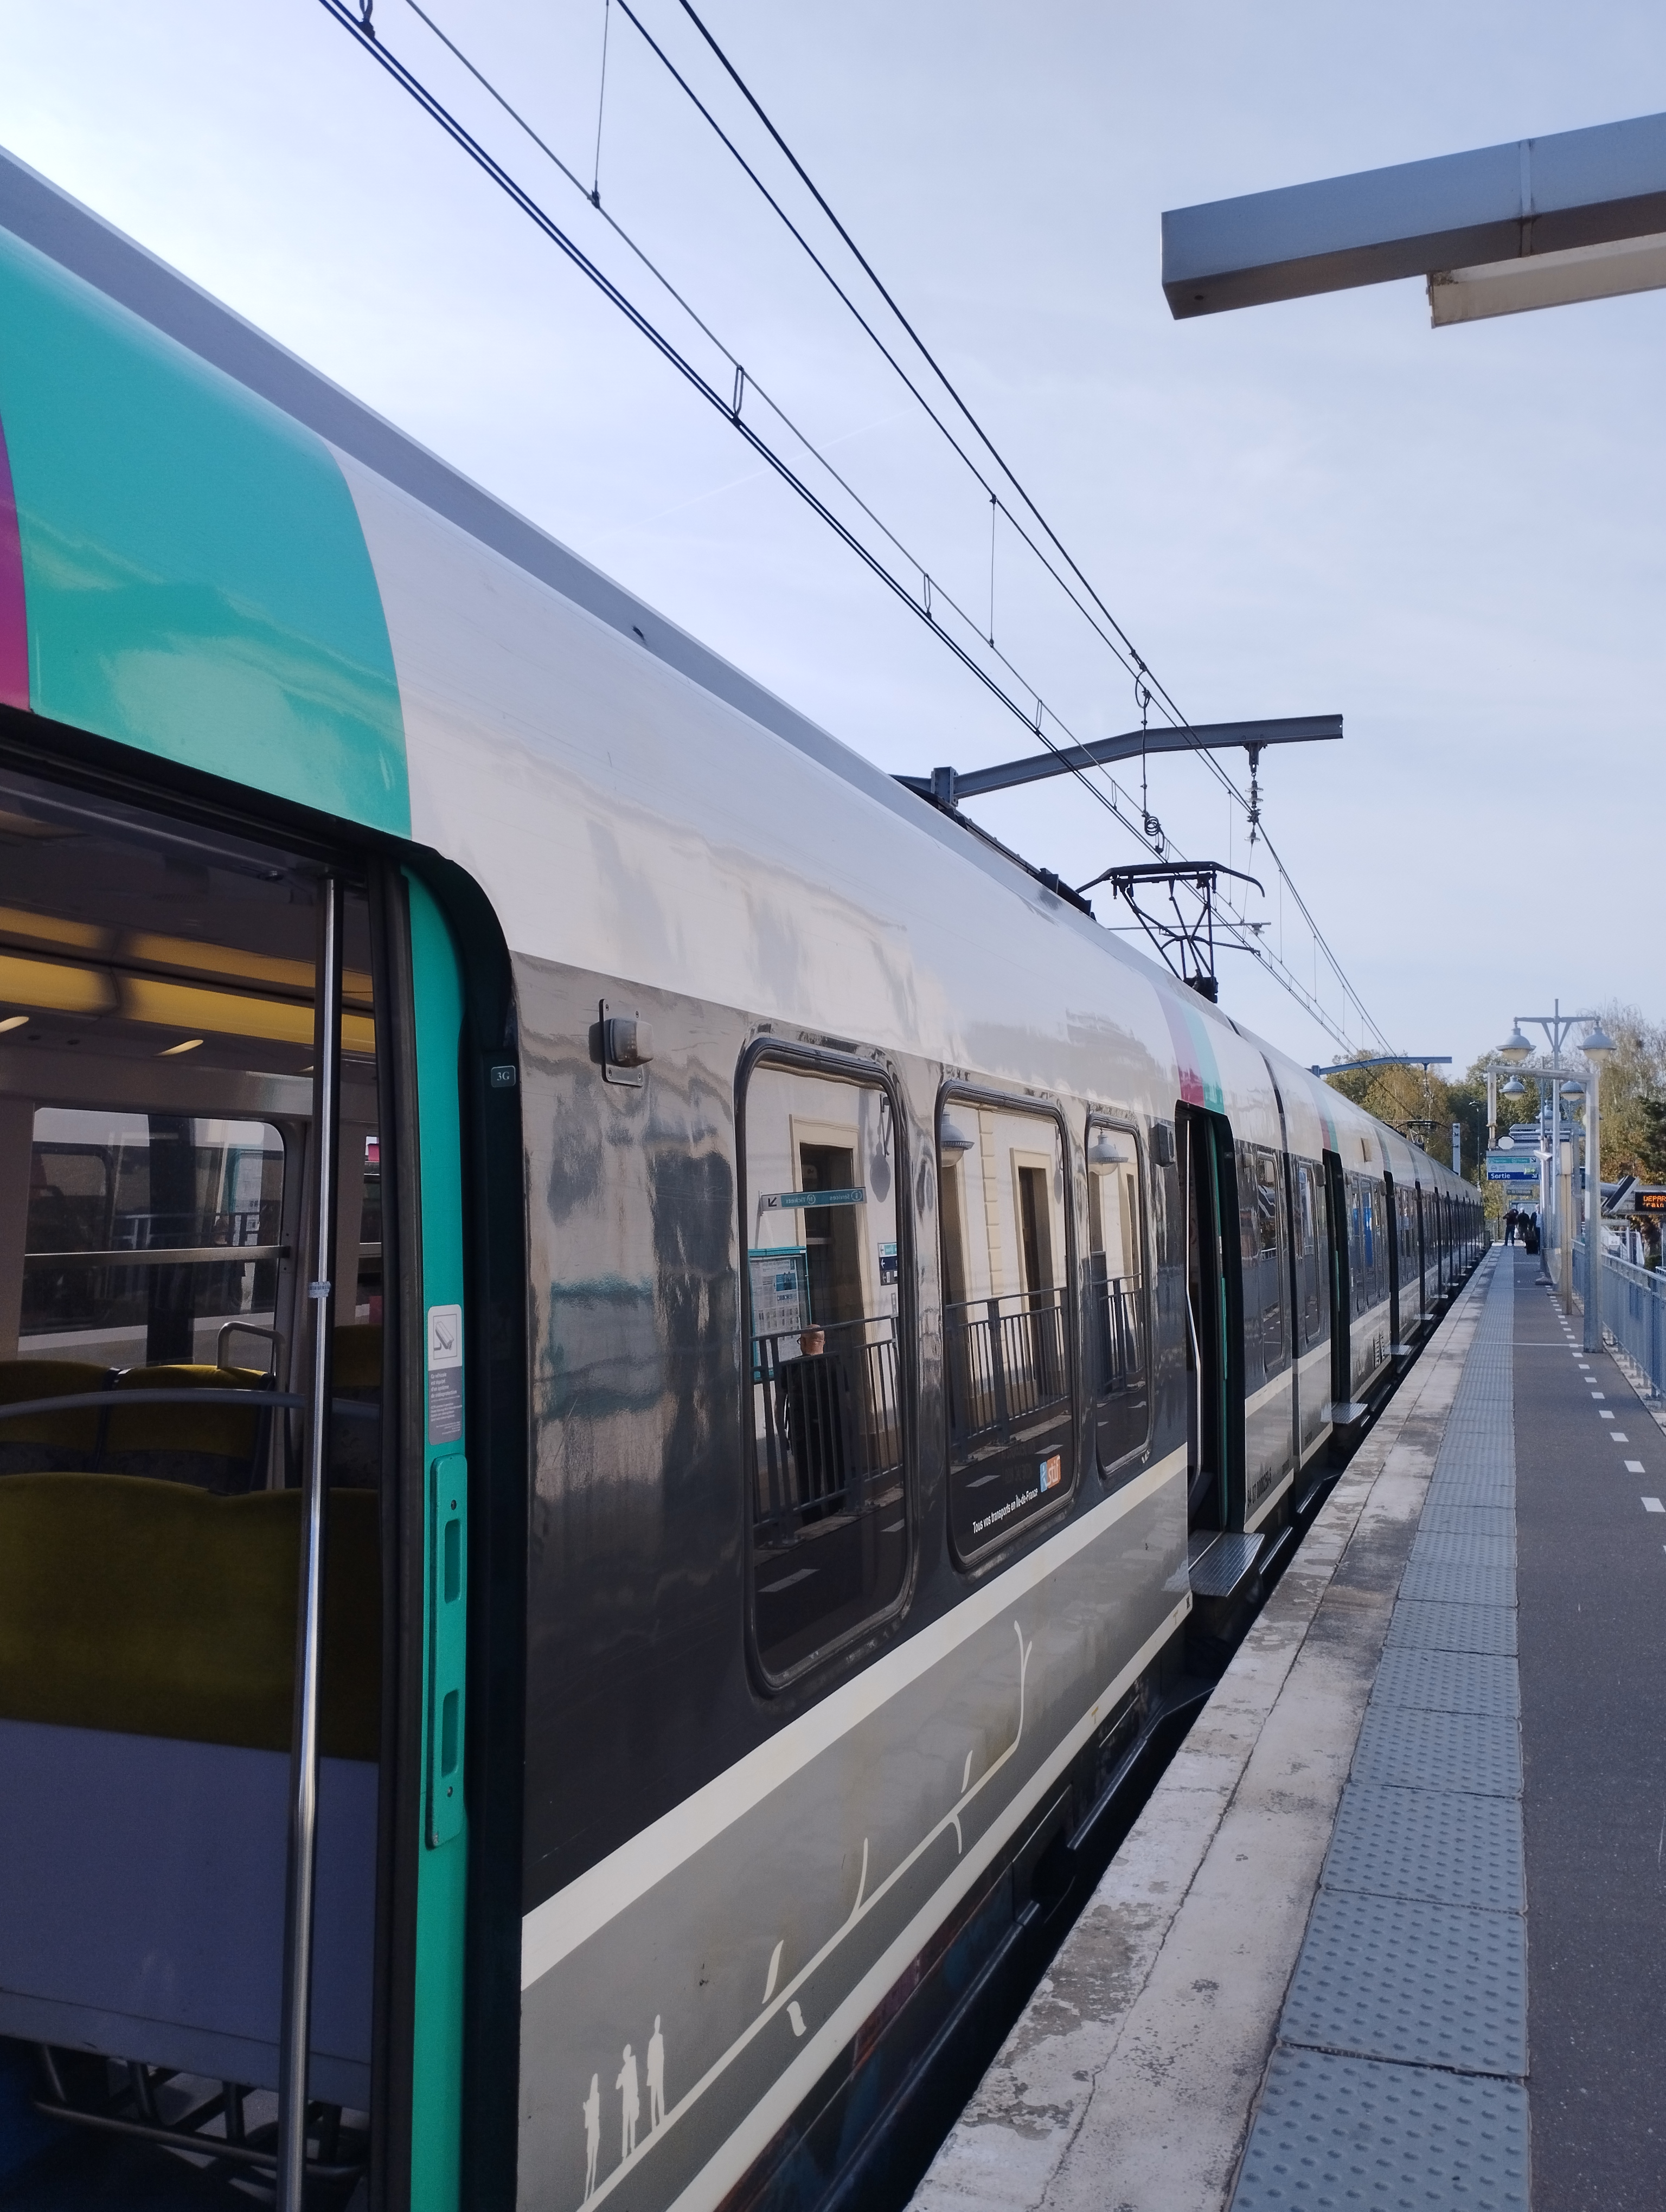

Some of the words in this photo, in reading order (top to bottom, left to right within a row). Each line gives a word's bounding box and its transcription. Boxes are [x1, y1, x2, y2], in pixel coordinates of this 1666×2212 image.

[497, 1071, 509, 1081] 3G
[1044, 1456, 1060, 1487] stif
[973, 1520, 983, 1534] Tous
[991, 1503, 1010, 1522] transports
[1011, 1501, 1016, 1510] en
